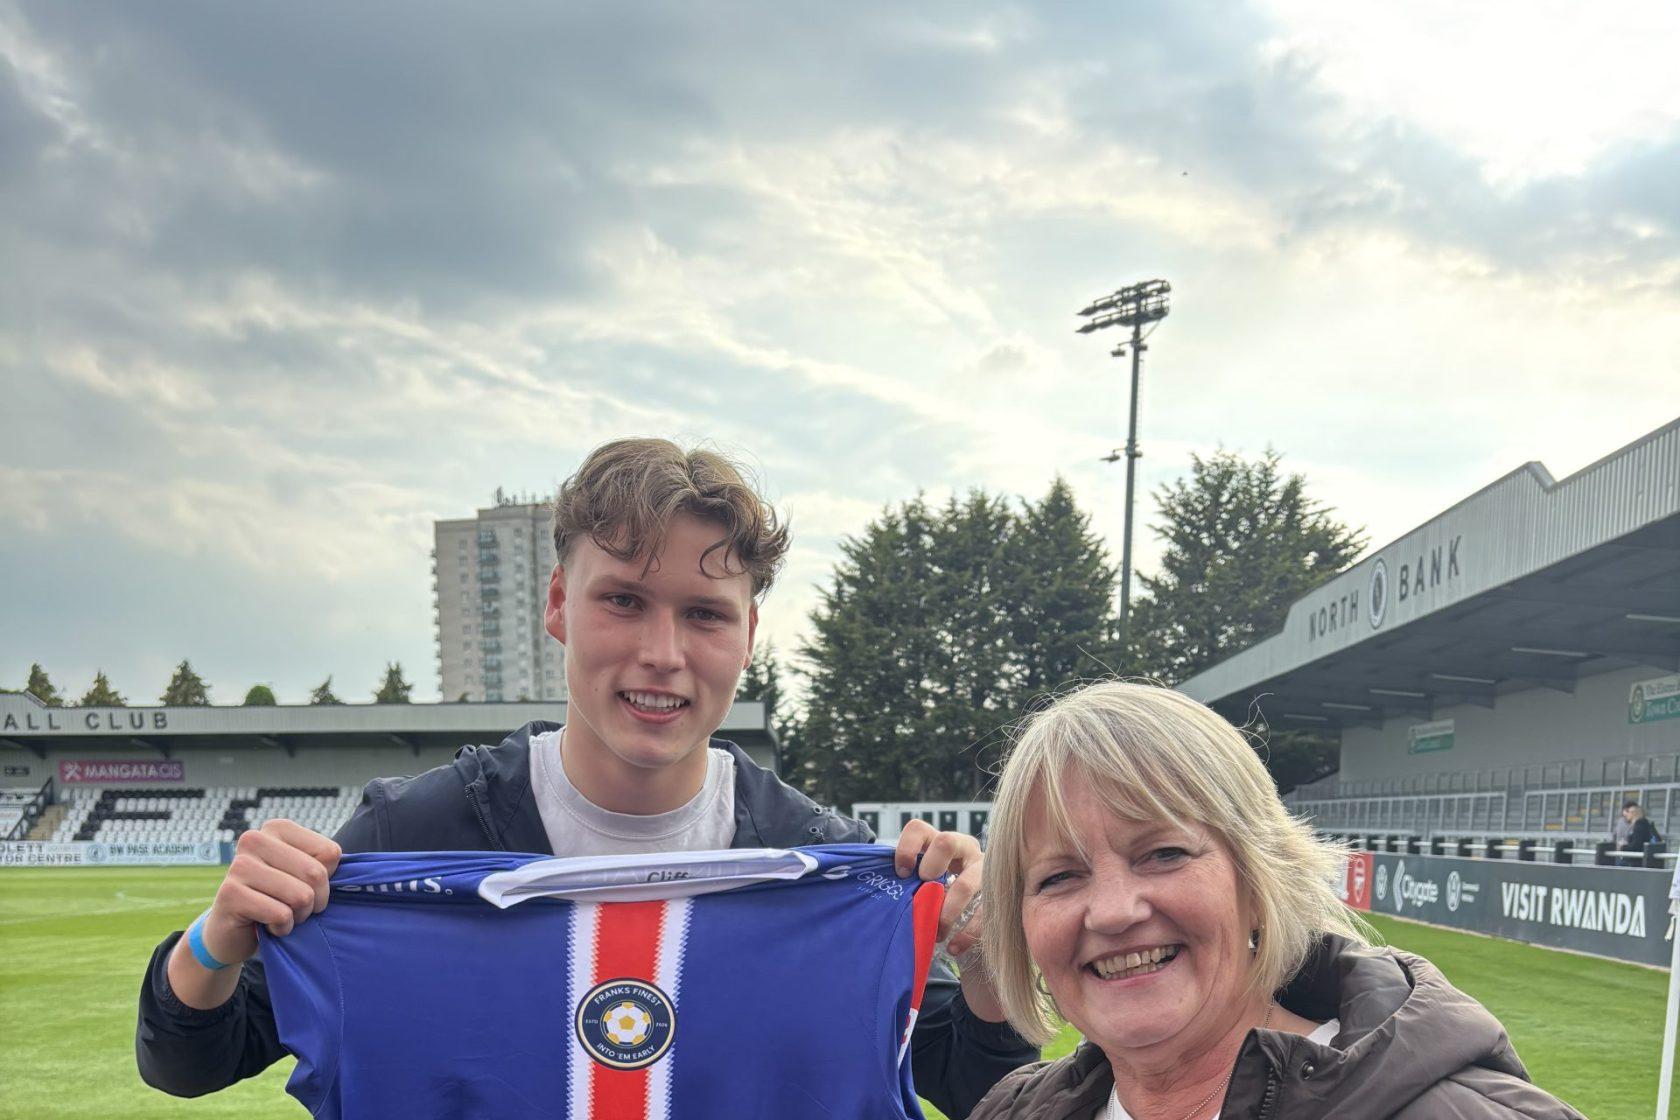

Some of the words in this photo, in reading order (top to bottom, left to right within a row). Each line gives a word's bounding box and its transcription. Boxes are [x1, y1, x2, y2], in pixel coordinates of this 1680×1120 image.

[1309, 590, 1359, 642] NORTH
[1399, 535, 1461, 602] BANK
[4, 713, 61, 730] ALL
[85, 712, 168, 730] CLUB
[28, 853, 81, 862] CENTRE
[647, 870, 689, 881] Cliff
[1502, 882, 1548, 922] VISIT
[1550, 887, 1646, 938] RWANDA
[594, 987, 631, 1005] FRANKS
[632, 988, 662, 1006] FINEST
[597, 1042, 616, 1058] INTO
[632, 1045, 656, 1060] EARLY
